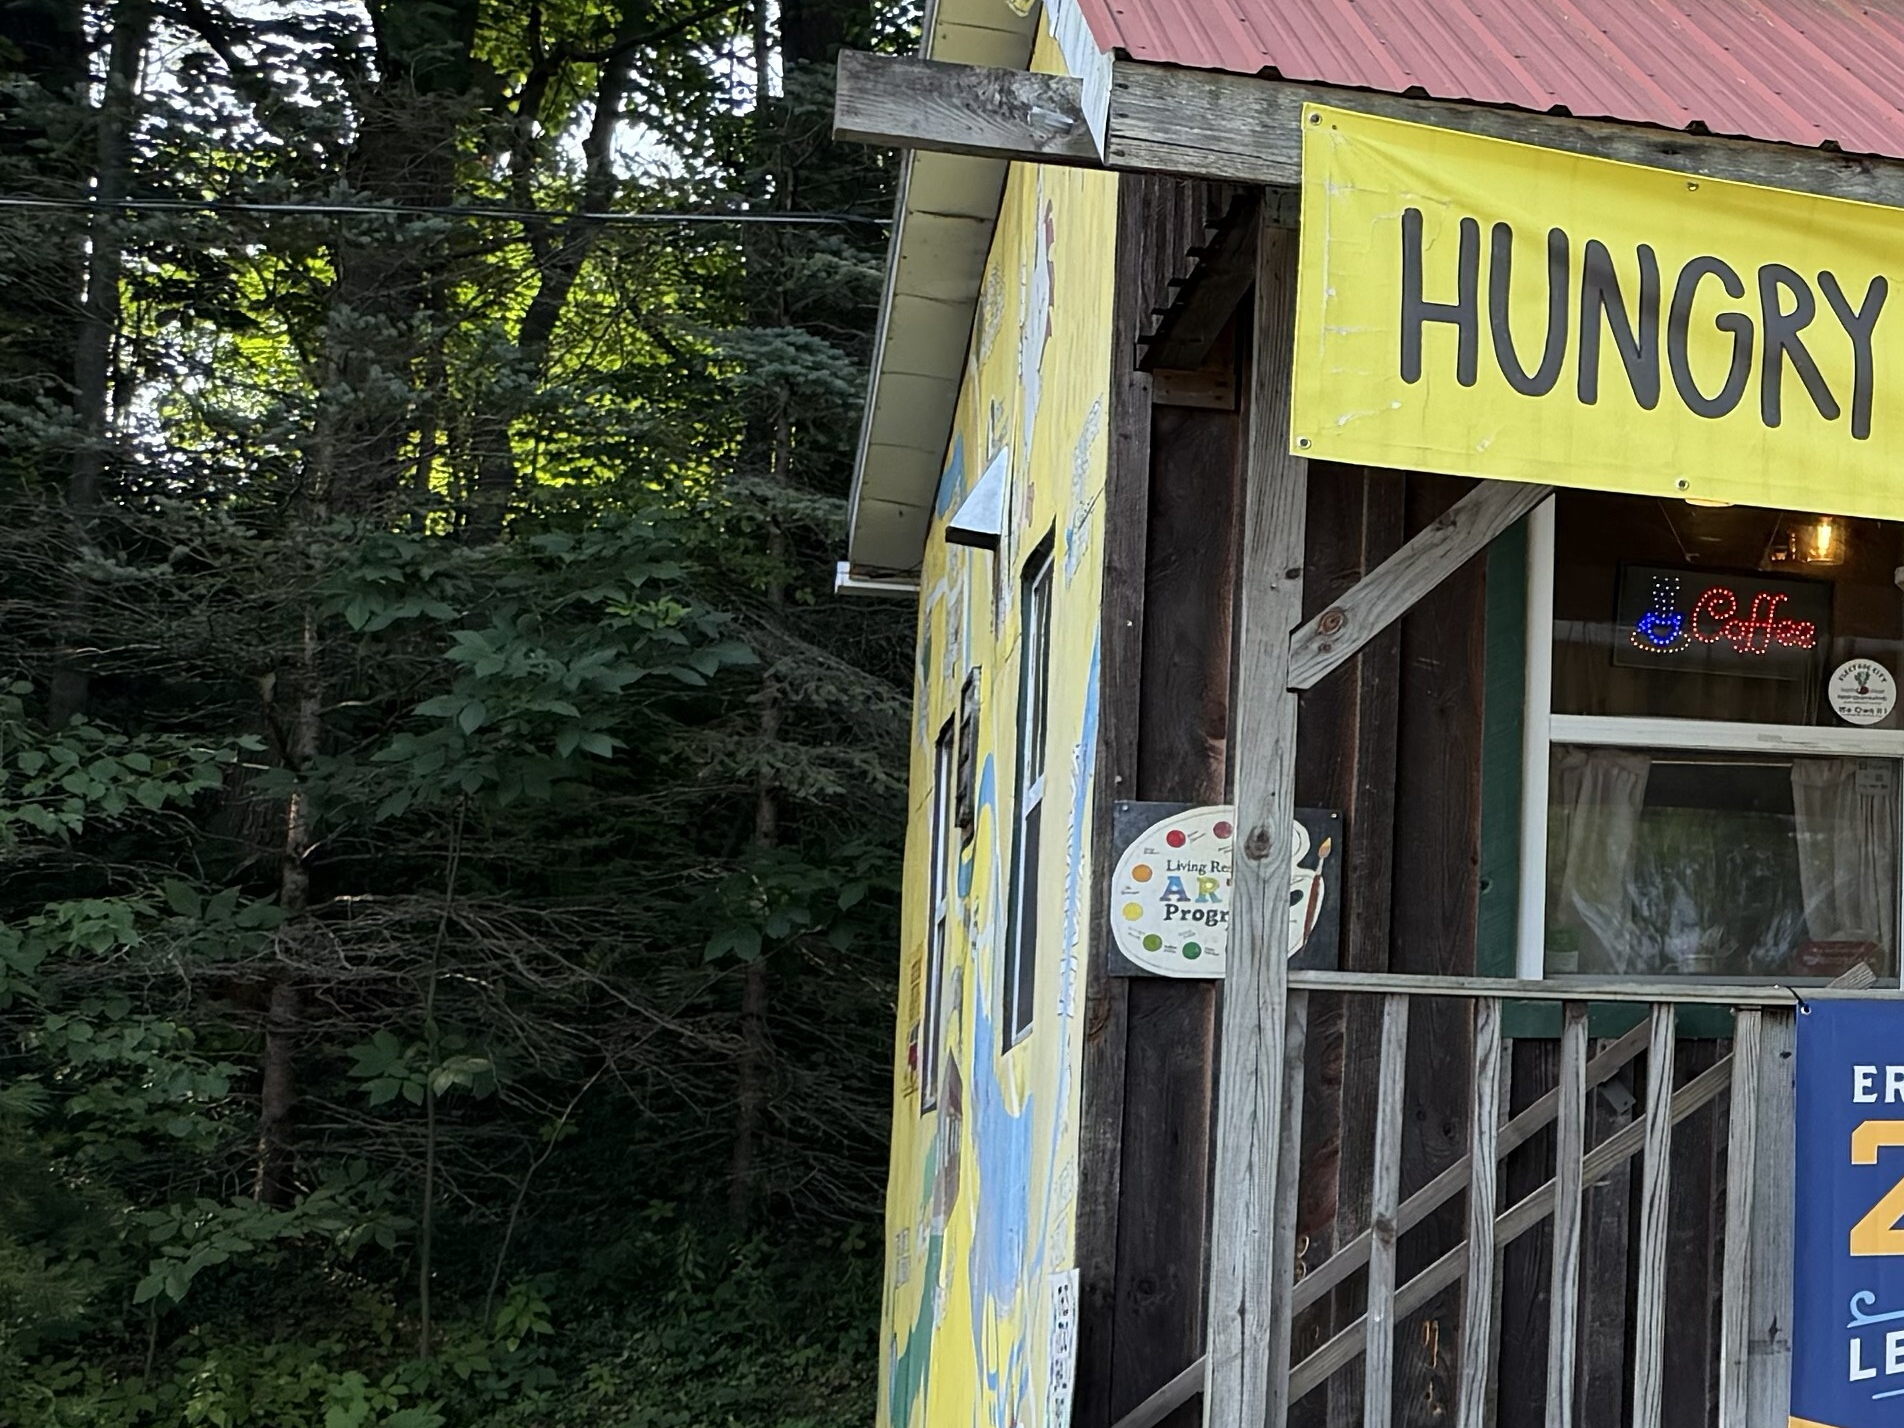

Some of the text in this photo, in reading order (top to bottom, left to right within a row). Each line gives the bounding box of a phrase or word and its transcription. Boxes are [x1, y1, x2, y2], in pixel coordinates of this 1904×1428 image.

[1400, 207, 1889, 440] HUNGRY
[1692, 586, 1817, 655] Coffee
[1166, 859, 1207, 876] Living
[1159, 875, 1224, 903] AR
[1163, 903, 1230, 927] Progr
